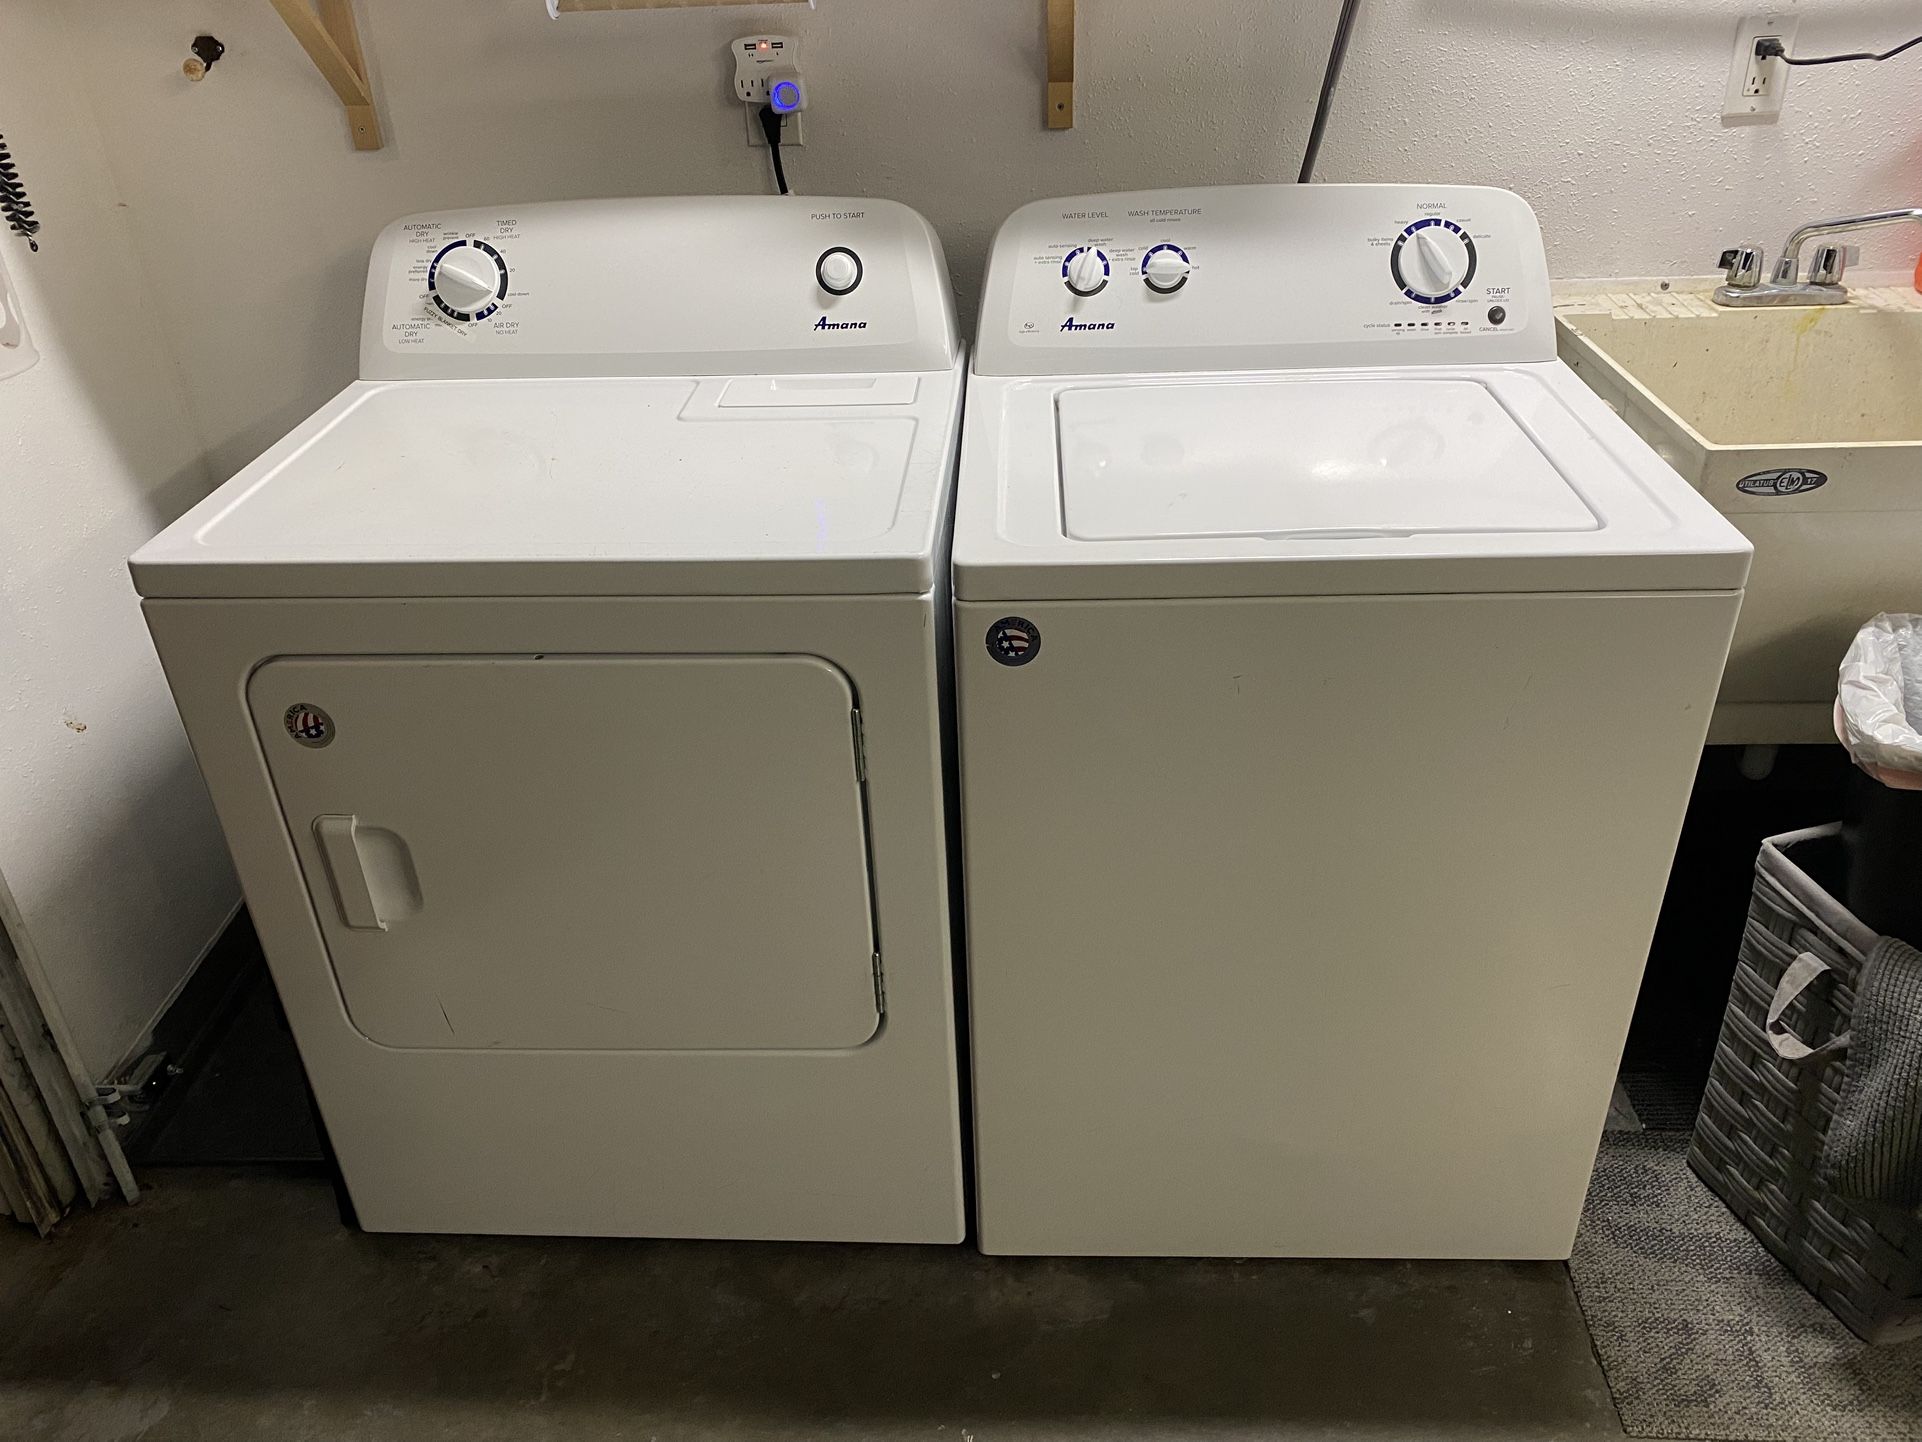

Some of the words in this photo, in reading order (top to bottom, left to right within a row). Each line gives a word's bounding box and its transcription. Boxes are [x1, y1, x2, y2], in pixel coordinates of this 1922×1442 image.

[404, 223, 441, 231] AUTOMATIC
[424, 306, 438, 318] FUZZY
[438, 316, 458, 331] BLANKET
[456, 328, 468, 336] DRY
[813, 316, 867, 331] Amana
[1060, 316, 1115, 332] Amana
